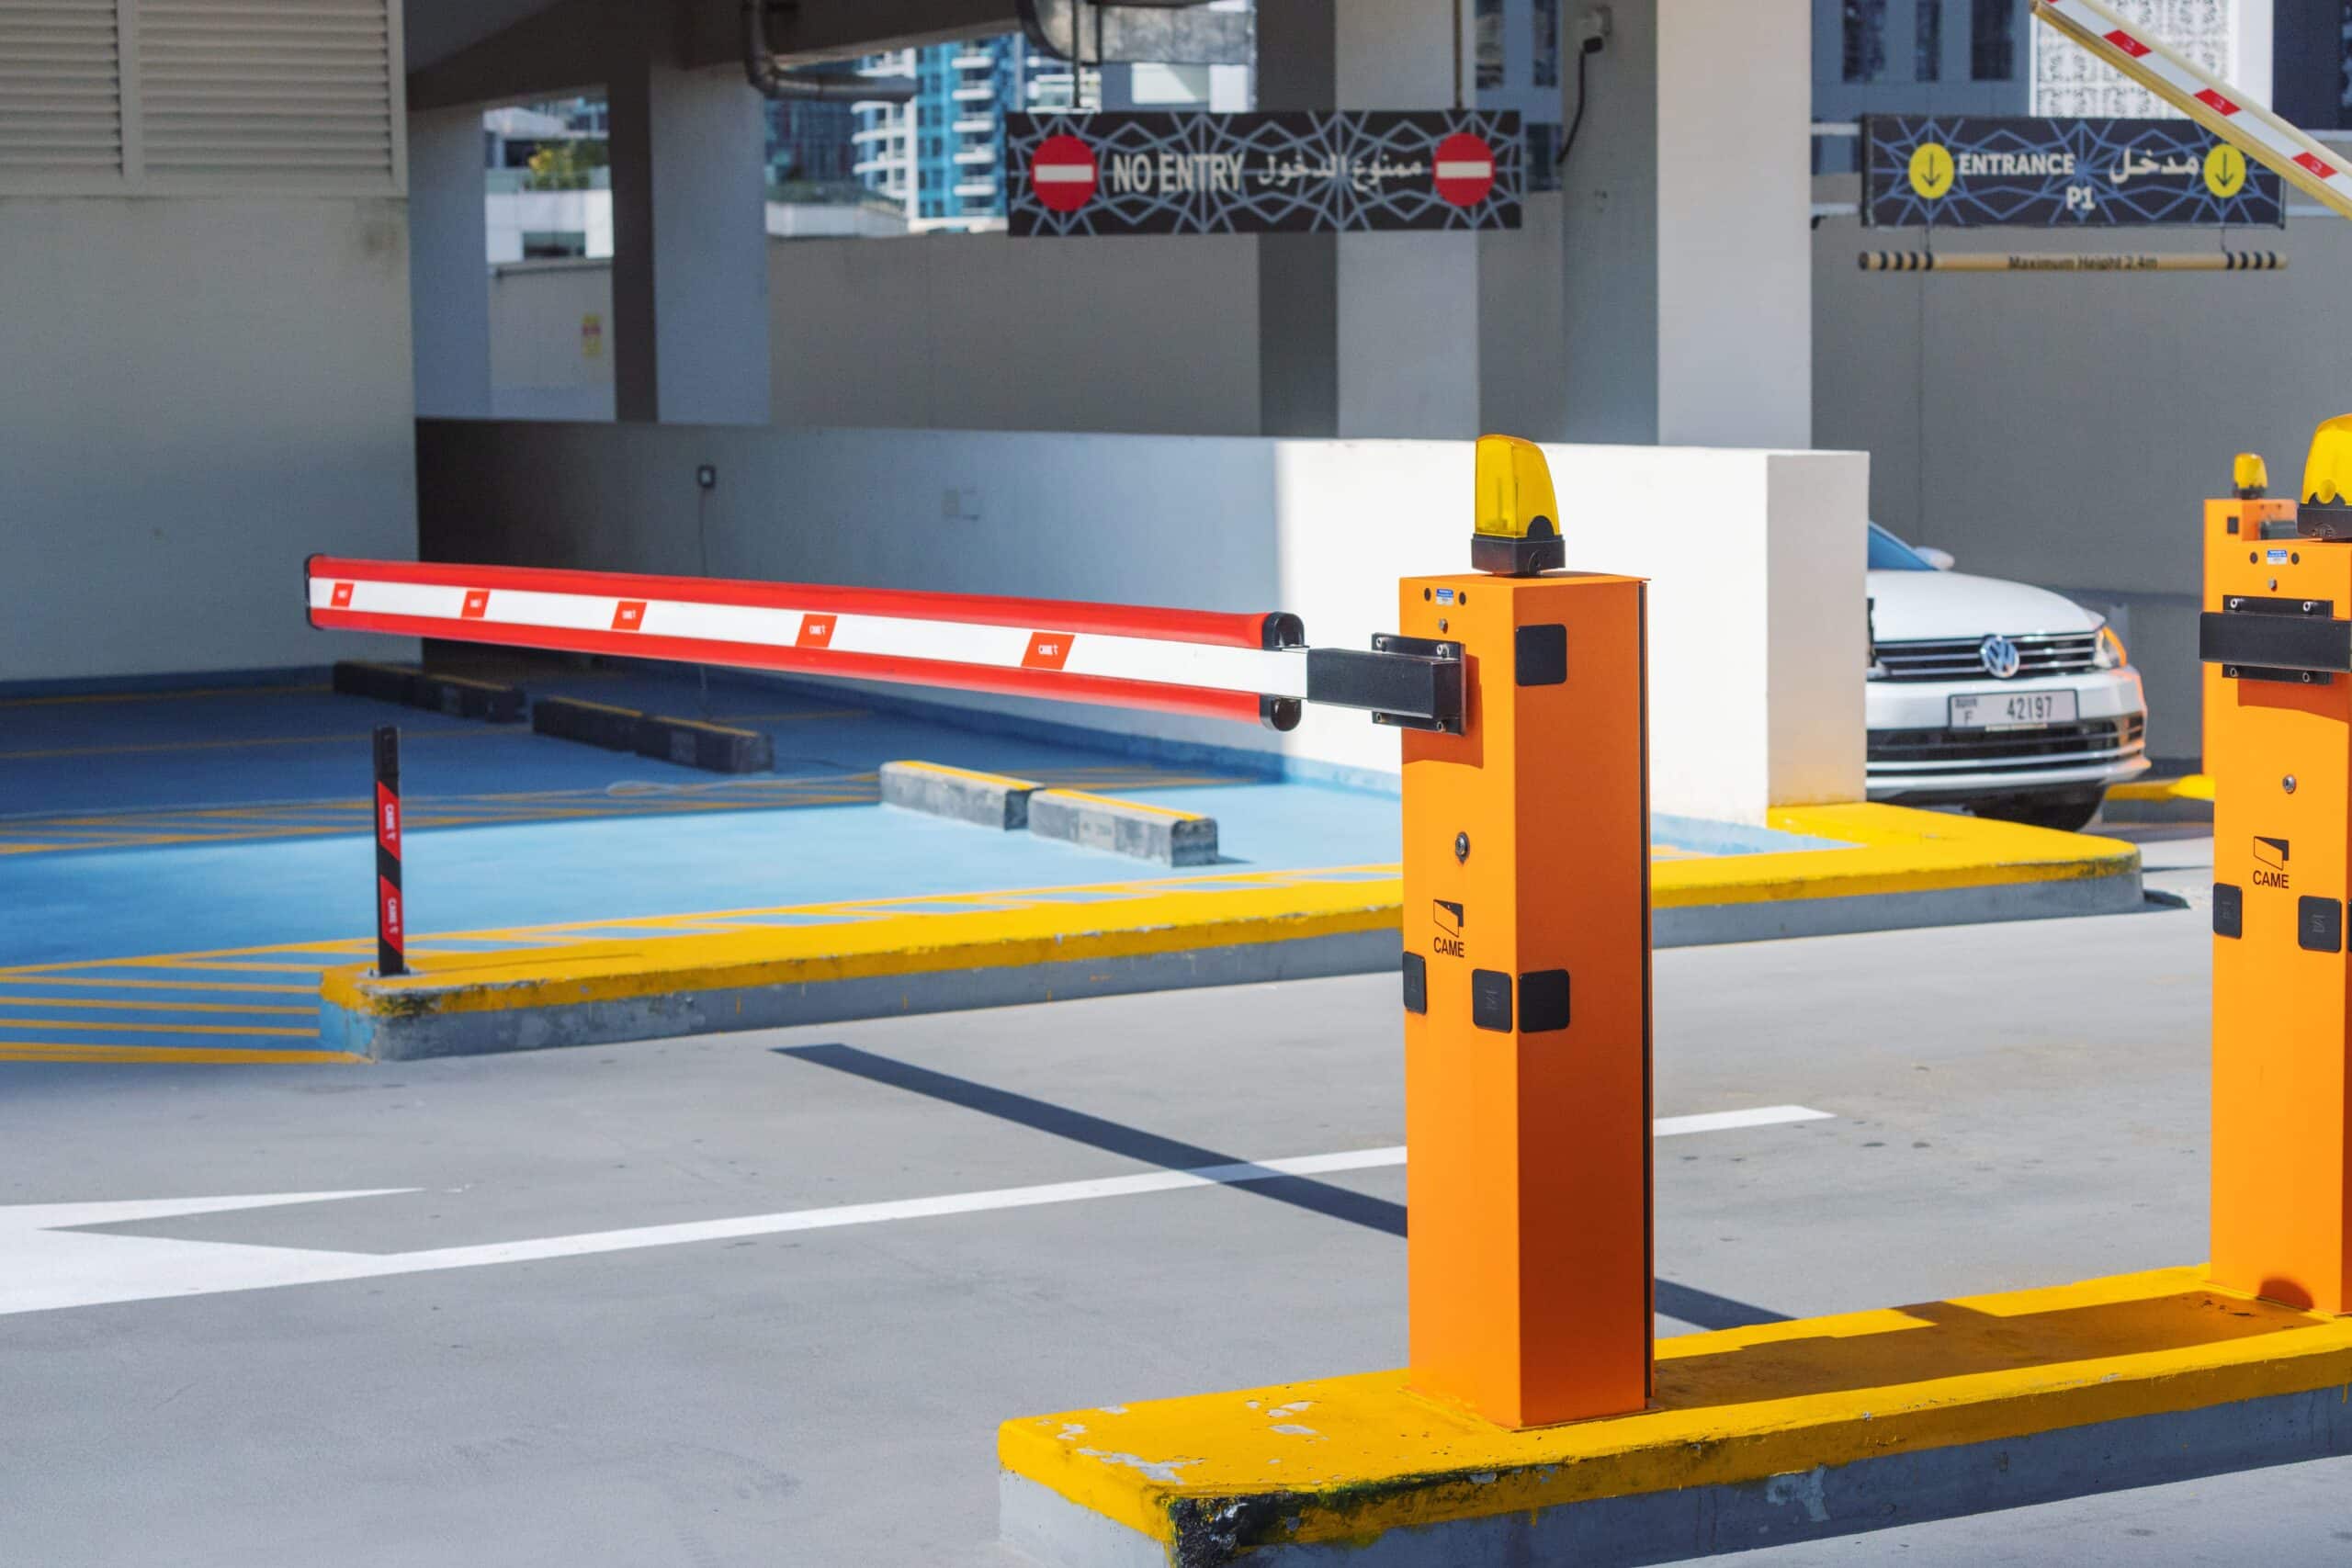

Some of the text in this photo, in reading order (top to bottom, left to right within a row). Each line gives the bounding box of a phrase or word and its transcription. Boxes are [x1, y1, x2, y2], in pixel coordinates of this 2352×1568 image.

[1113, 152, 1244, 192] NO ENTRY
[1958, 152, 2075, 176] ENTRANCE
[2109, 146, 2199, 184] مدخل
[2066, 186, 2096, 210] P1
[2008, 254, 2158, 273] Maximum Height 2.4m
[2007, 696, 2052, 720] 42197
[2253, 870, 2290, 889] CAME
[1433, 936, 1465, 958] CAME
